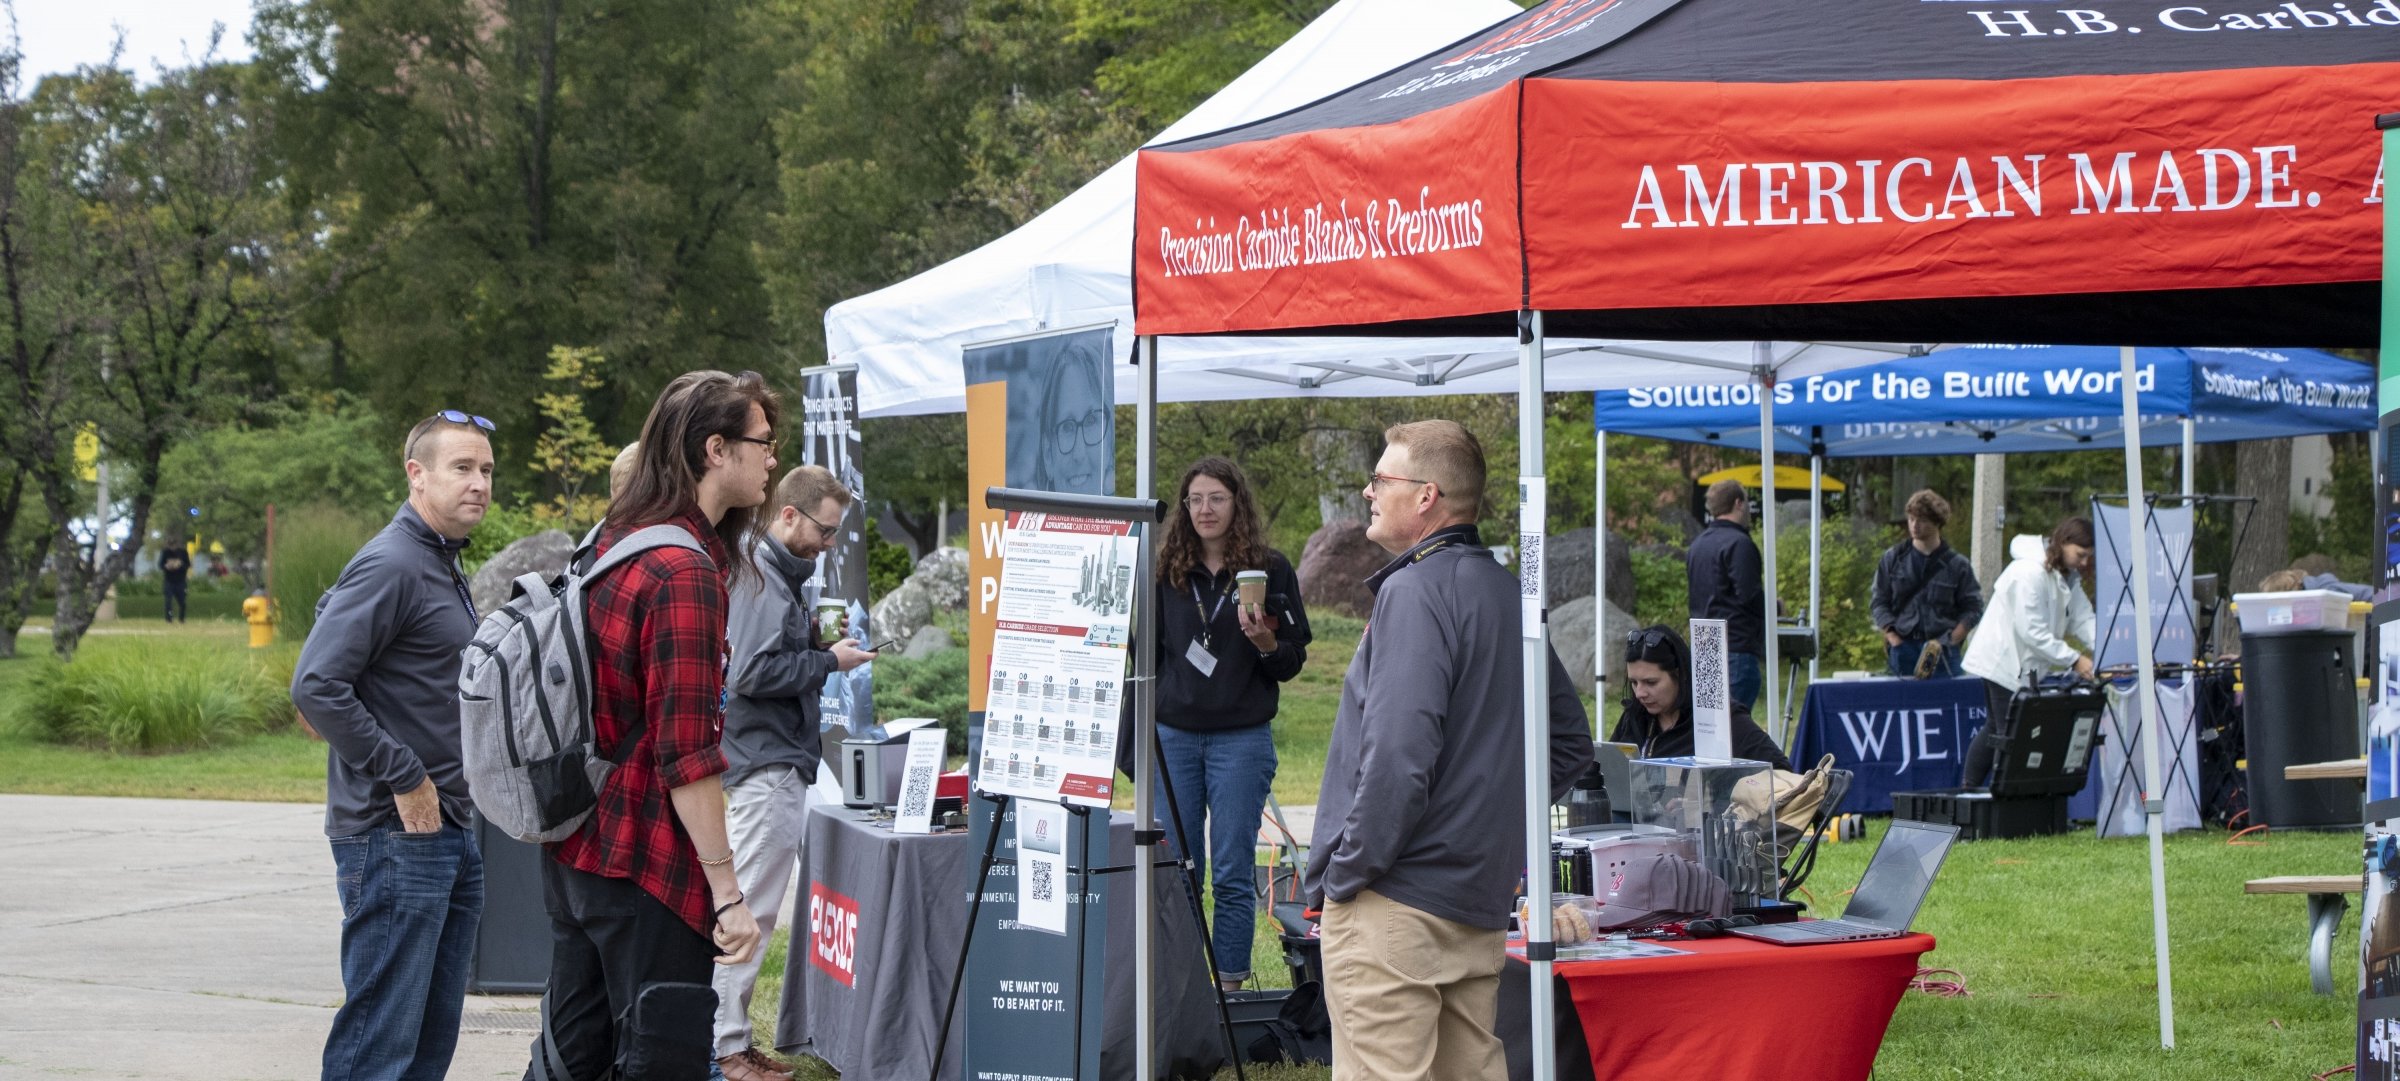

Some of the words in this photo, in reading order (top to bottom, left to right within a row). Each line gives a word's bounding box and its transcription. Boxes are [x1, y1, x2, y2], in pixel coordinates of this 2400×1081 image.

[1967, 10, 2142, 37] H.B.
[1621, 154, 2046, 228] AMERICAN
[2067, 145, 2321, 214] MADE.
[1161, 216, 1233, 277] Precision
[1236, 206, 1300, 272] Carbide
[1303, 198, 1366, 264] Blanks
[1366, 200, 1386, 259] &
[1386, 186, 1483, 257] Preforms
[1807, 375, 1860, 403] for
[1872, 372, 1930, 400] the
[1943, 370, 2030, 398] Built
[2043, 364, 2155, 395] Word
[2201, 366, 2260, 401] Solutions
[2261, 376, 2280, 402] for
[2280, 377, 2303, 405] the
[2305, 381, 2333, 407] Built
[2335, 384, 2371, 409] World
[1045, 521, 1072, 530] ADVANTAGE
[1073, 523, 1083, 531] CAN
[1091, 524, 1100, 532] FOR
[802, 576, 827, 588] USTRIAL
[1838, 708, 1948, 776] WJE
[810, 894, 857, 974] PLEXUS
[1000, 980, 1014, 992] WE
[1016, 981, 1040, 993] WANT
[1042, 982, 1059, 994] YOU
[993, 997, 1005, 1009] TO
[1007, 998, 1017, 1010] BE
[1019, 998, 1040, 1011] PART
[1042, 999, 1053, 1012] OF
[1055, 1000, 1065, 1012] IT.
[978, 1072, 993, 1080] WANT
[994, 1072, 1001, 1081] TO
